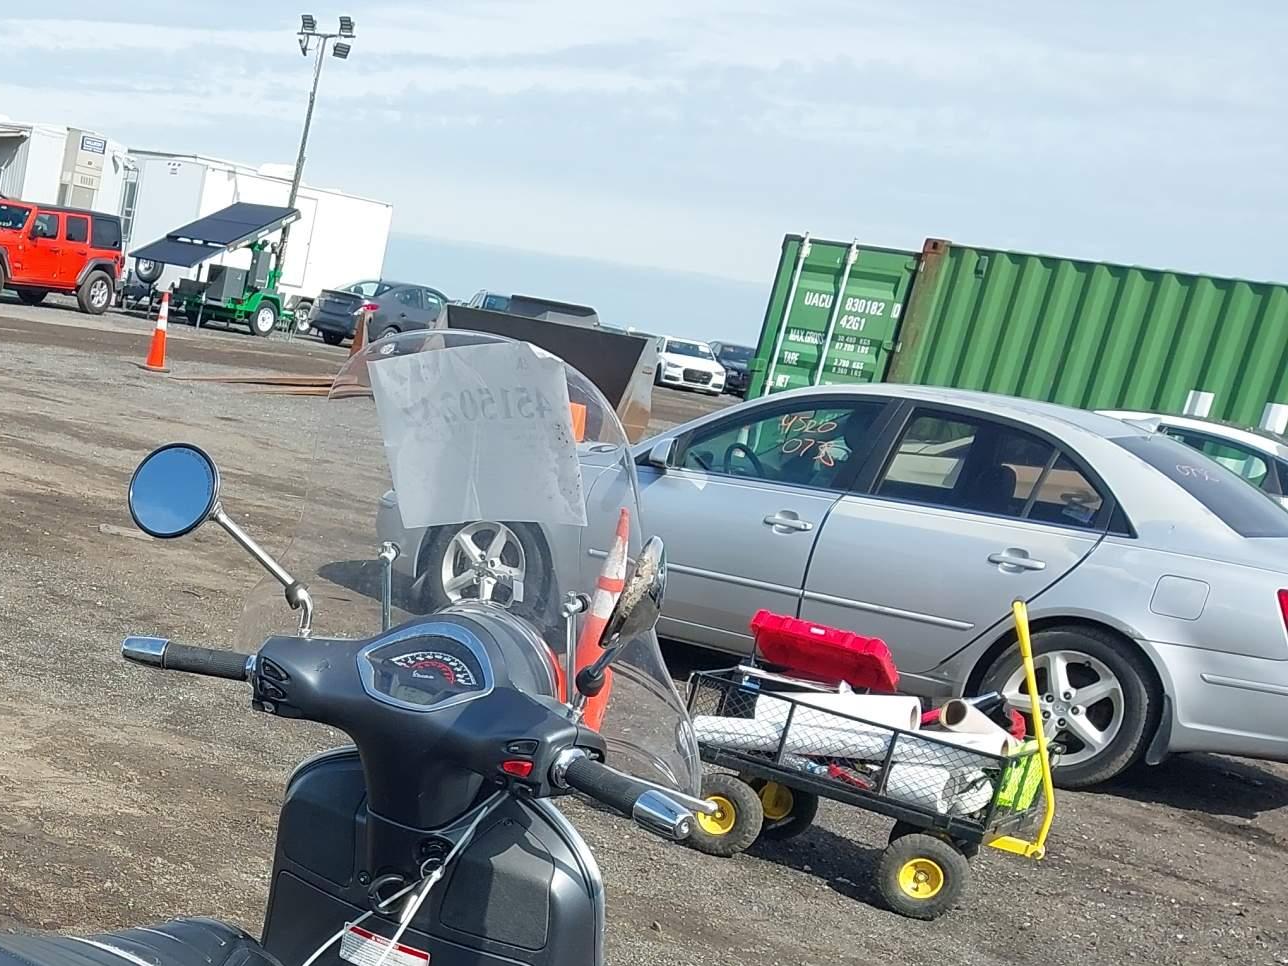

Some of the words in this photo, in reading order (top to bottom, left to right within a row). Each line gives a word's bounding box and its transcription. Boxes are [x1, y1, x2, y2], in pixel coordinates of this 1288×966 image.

[804, 291, 833, 309] UACU
[845, 297, 886, 316] 830182
[839, 314, 866, 331] 42G1
